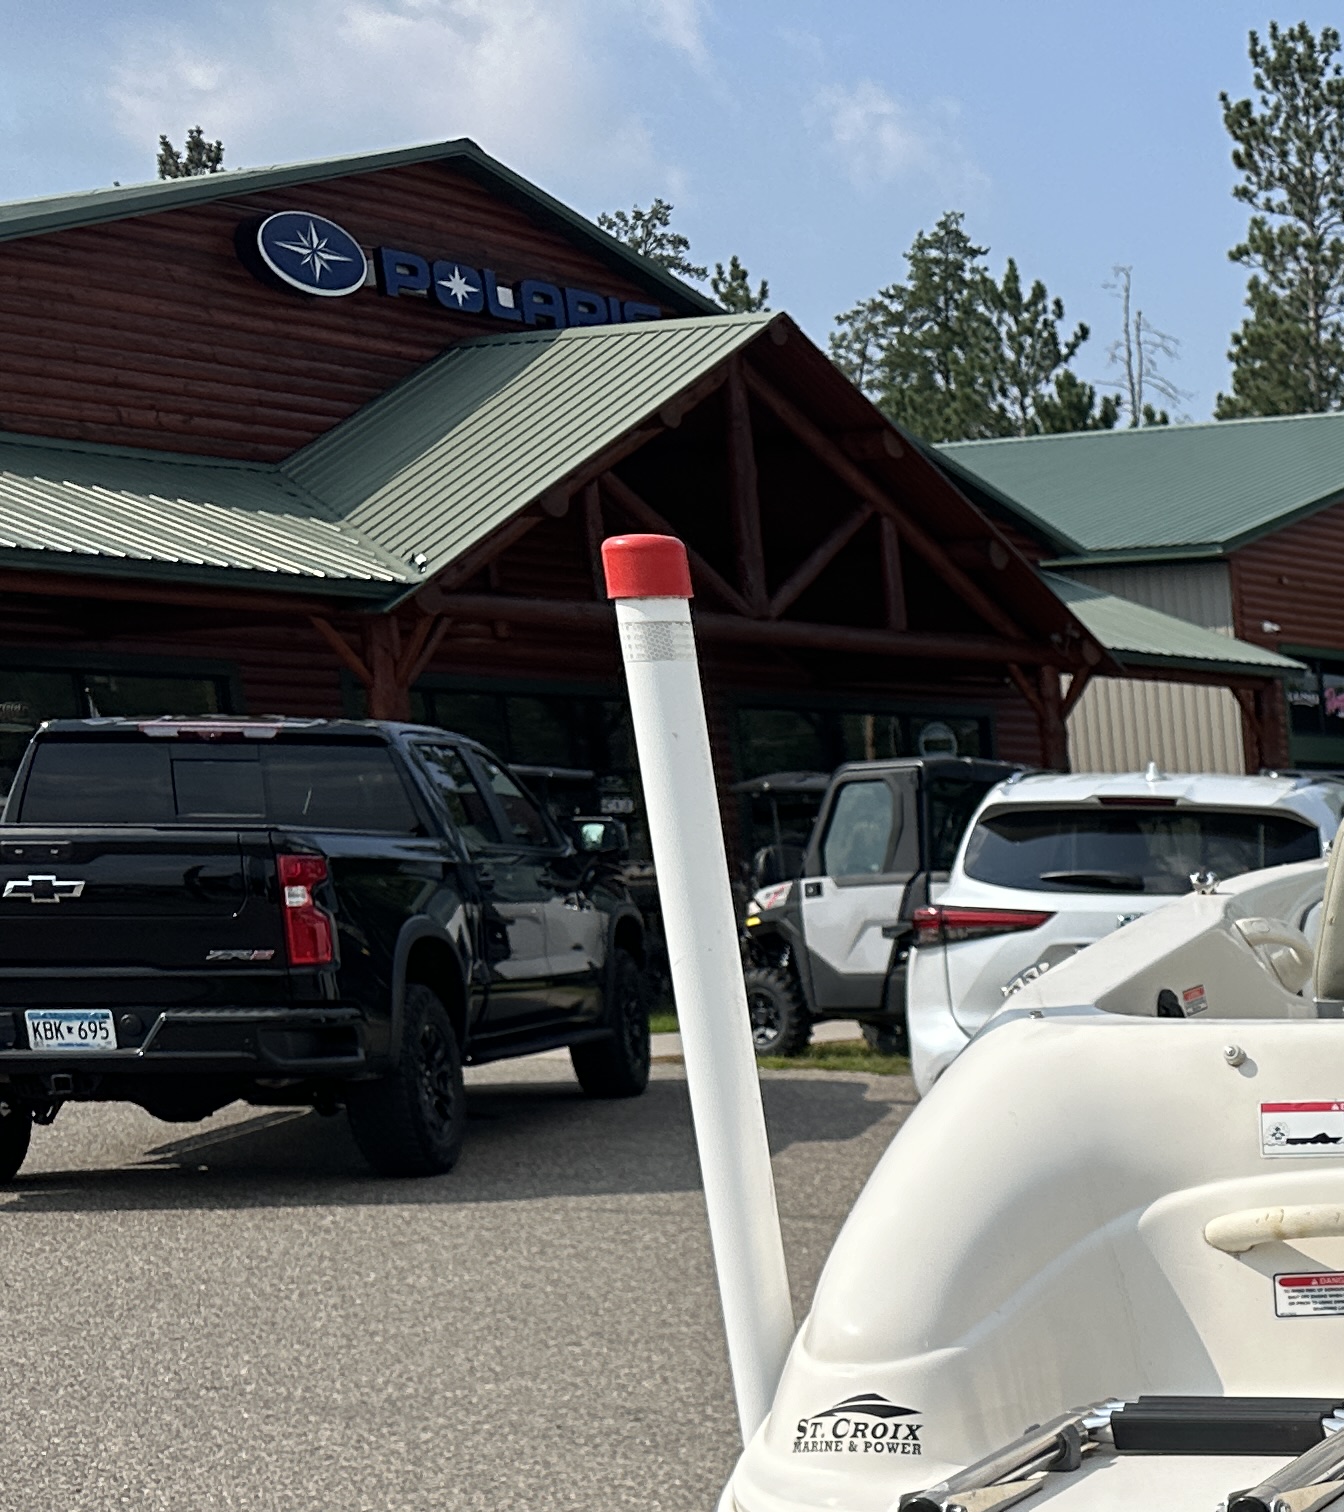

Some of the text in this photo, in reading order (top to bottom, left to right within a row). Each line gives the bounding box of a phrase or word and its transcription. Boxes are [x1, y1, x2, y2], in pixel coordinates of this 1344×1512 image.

[32, 1021, 109, 1040] KBK 695
[796, 1418, 923, 1440] ST. CROIX
[793, 1440, 922, 1455] MARINE & POWER
